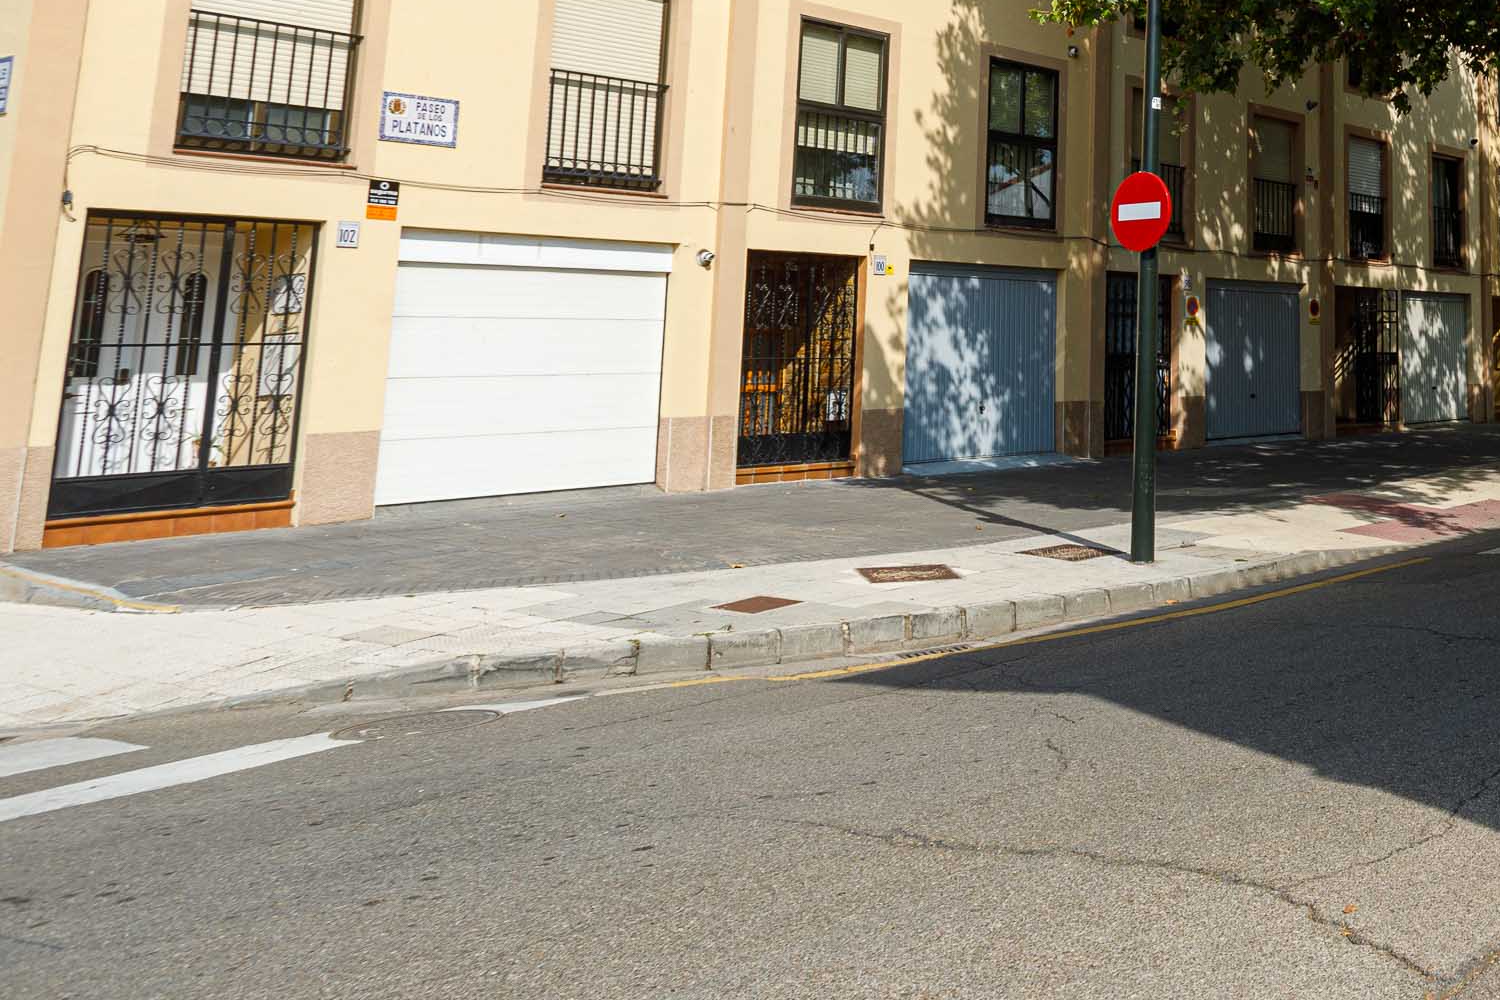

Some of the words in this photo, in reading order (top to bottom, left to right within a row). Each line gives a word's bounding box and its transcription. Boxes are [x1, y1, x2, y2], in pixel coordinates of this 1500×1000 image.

[415, 101, 446, 115] PASEO
[417, 112, 426, 121] DE
[429, 114, 443, 122] LOS
[392, 119, 448, 138] PLATANOS
[339, 229, 357, 243] 102
